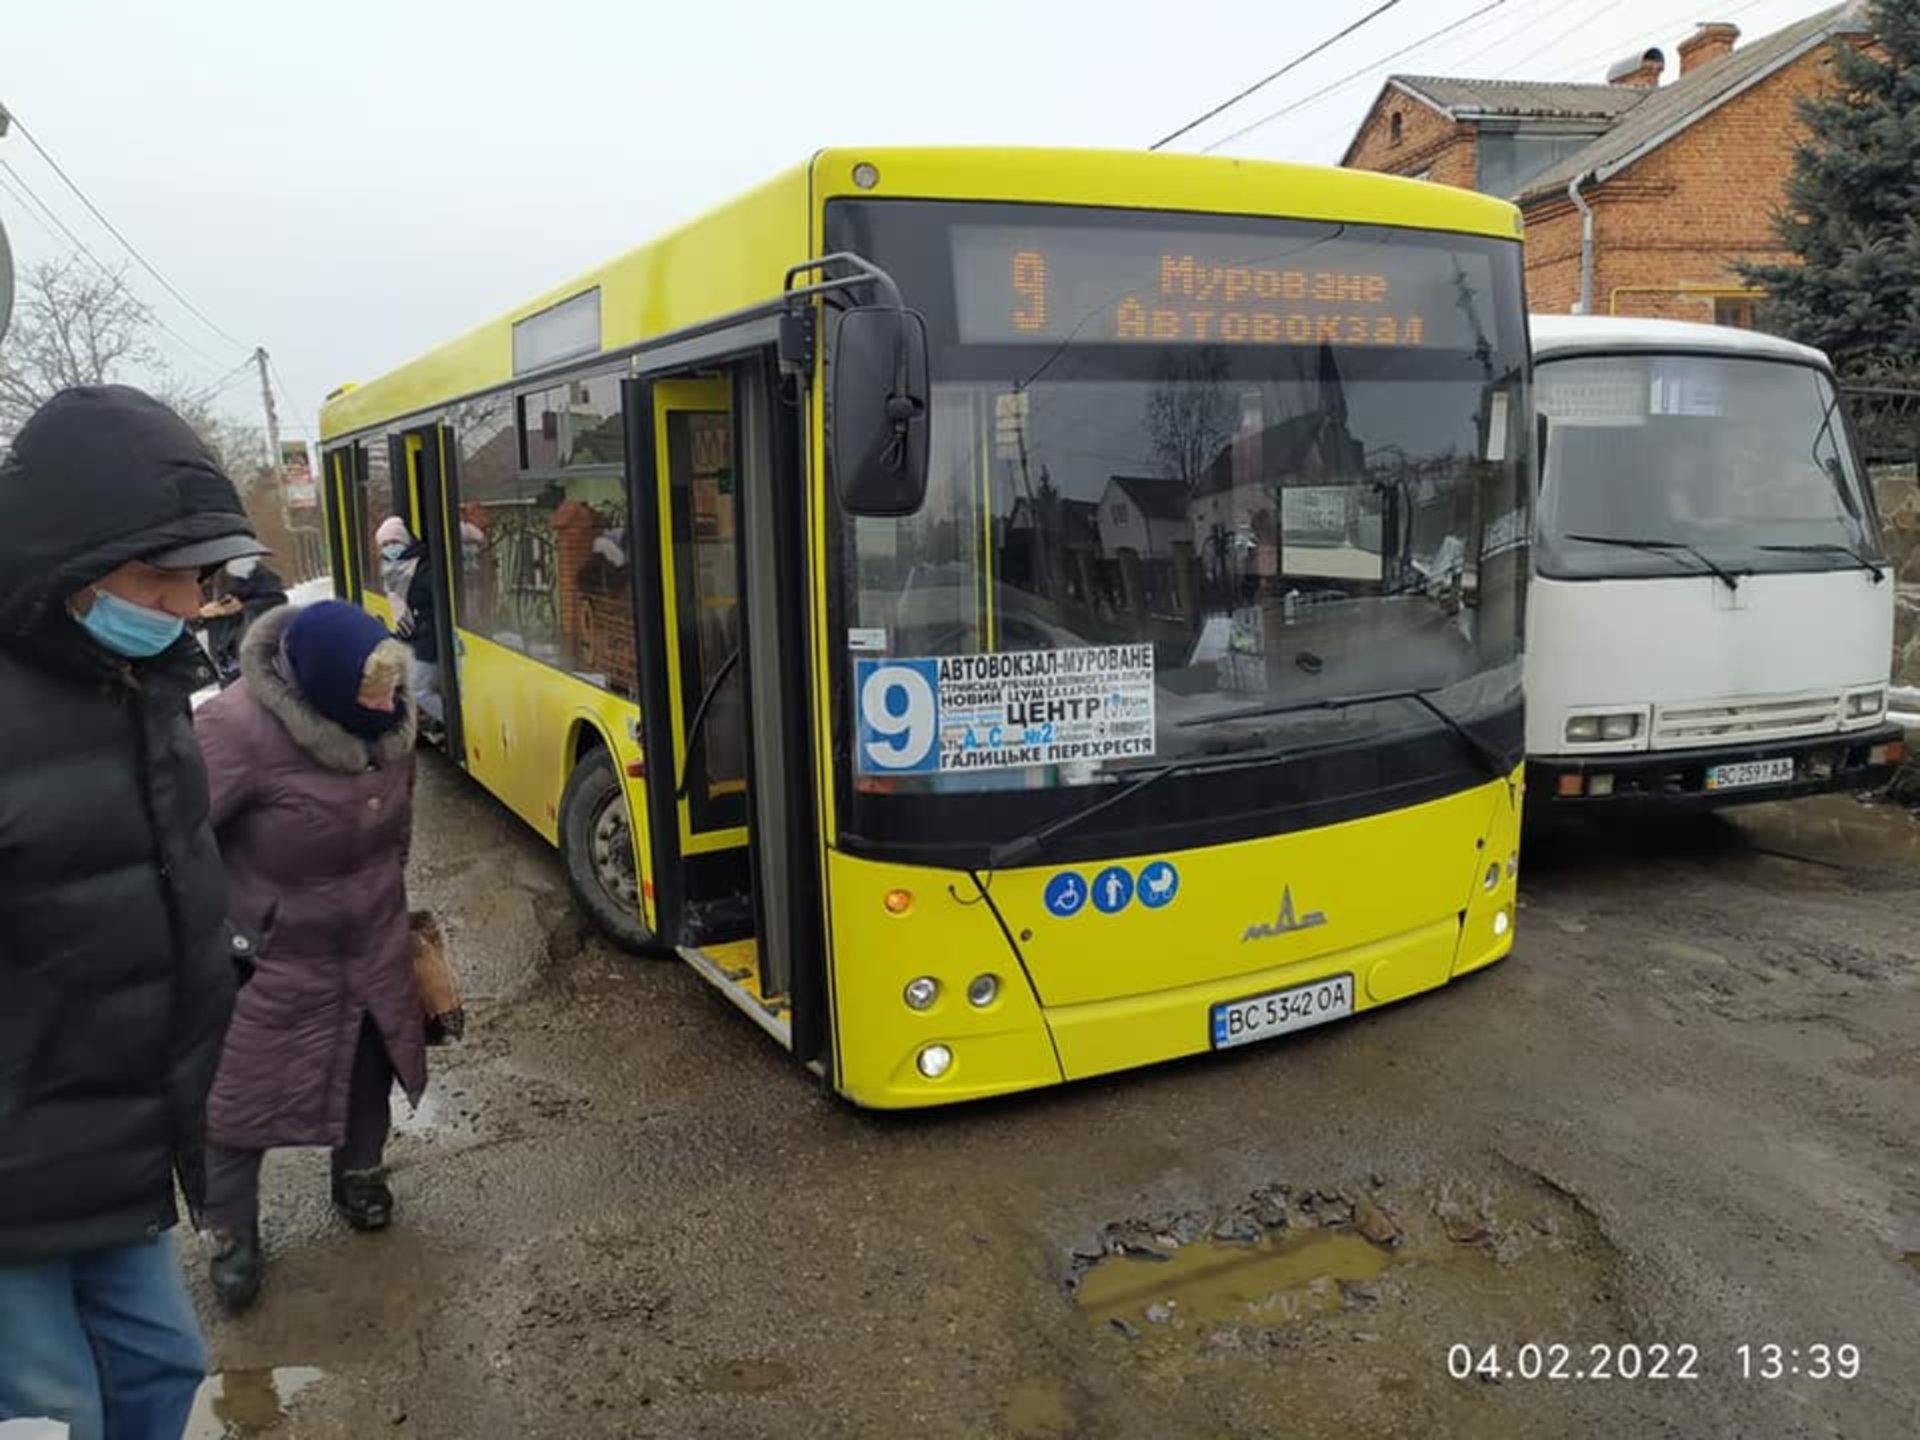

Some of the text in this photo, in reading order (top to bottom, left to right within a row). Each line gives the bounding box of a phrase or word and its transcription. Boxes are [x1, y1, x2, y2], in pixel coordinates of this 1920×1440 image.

[1011, 252, 1045, 329] 9
[1160, 254, 1389, 302] Муроване
[1117, 297, 1425, 346] Автовокзал
[861, 665, 936, 769] 9
[941, 691, 1001, 707] НОВИЙ
[1007, 688, 1044, 703] ЦУМ
[1007, 697, 1100, 728] ЦЕНТР
[941, 737, 1152, 768] ГАЛИЦЬКЕ ПЕРЕХРЕСТЯ
[1266, 991, 1313, 1025] 5342
